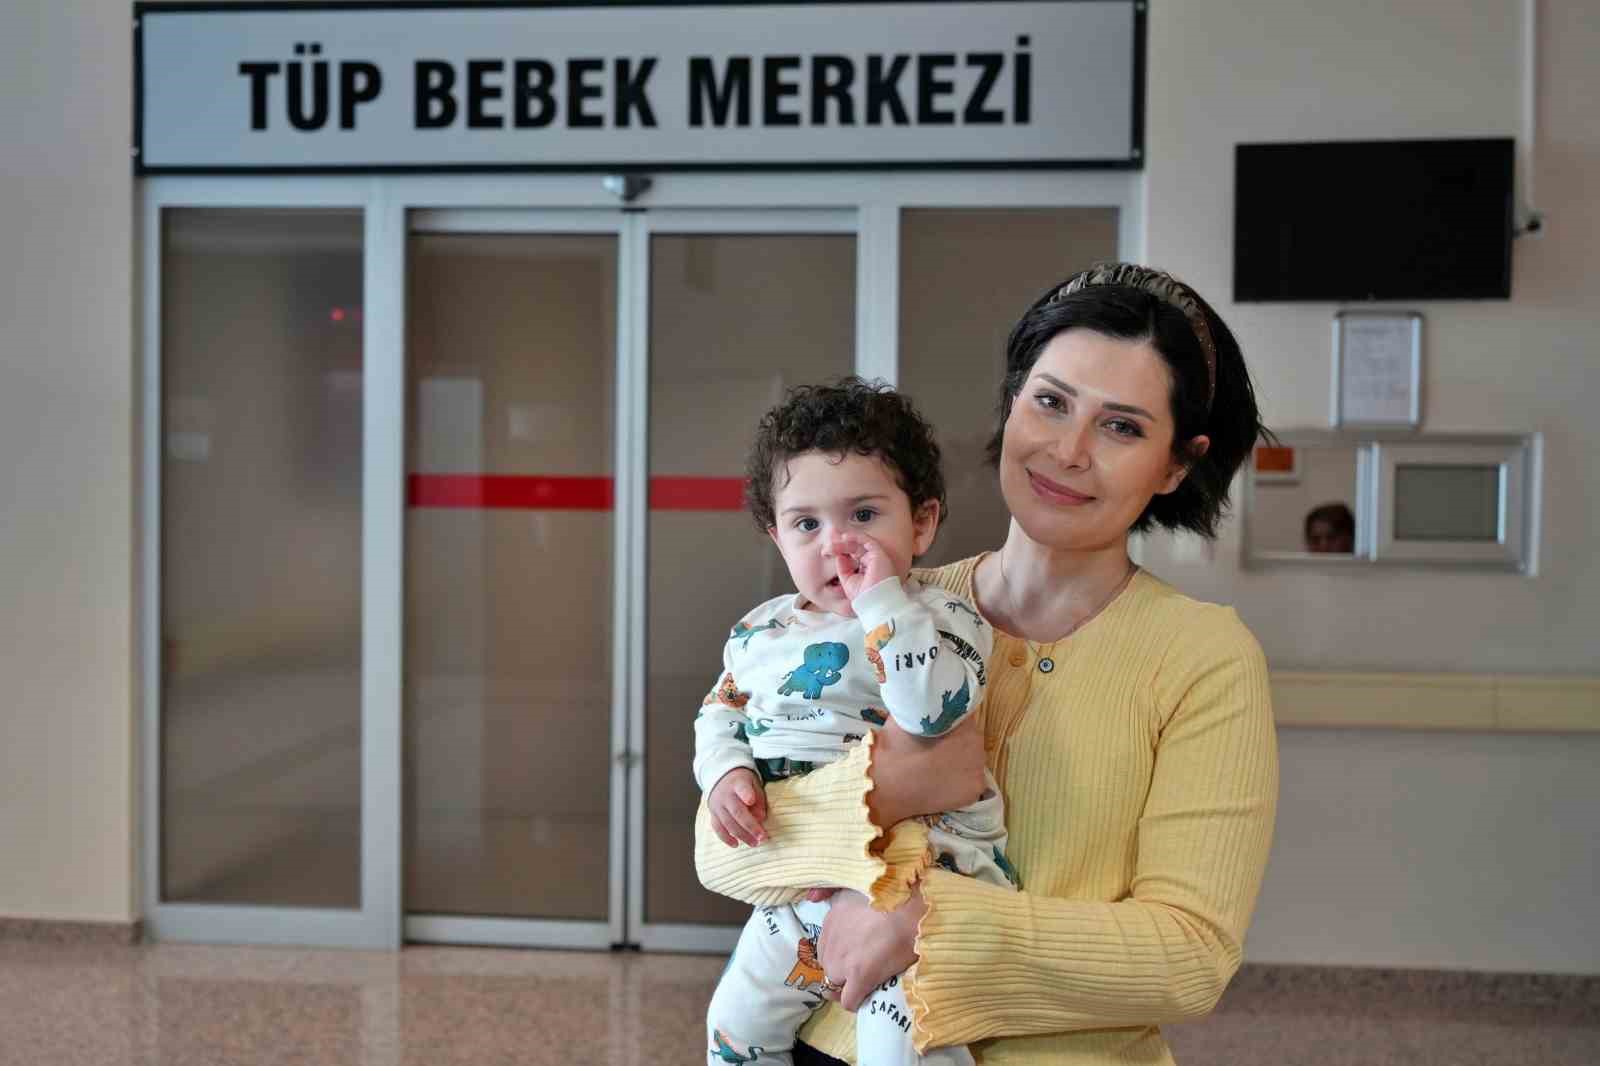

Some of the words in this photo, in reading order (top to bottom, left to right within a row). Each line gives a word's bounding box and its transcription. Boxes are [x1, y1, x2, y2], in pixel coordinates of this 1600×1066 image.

[239, 43, 382, 131] TÜP
[415, 58, 657, 129] BEBEK
[689, 35, 1031, 126] MERKEZİ
[870, 1000, 911, 1032] SAFARI
